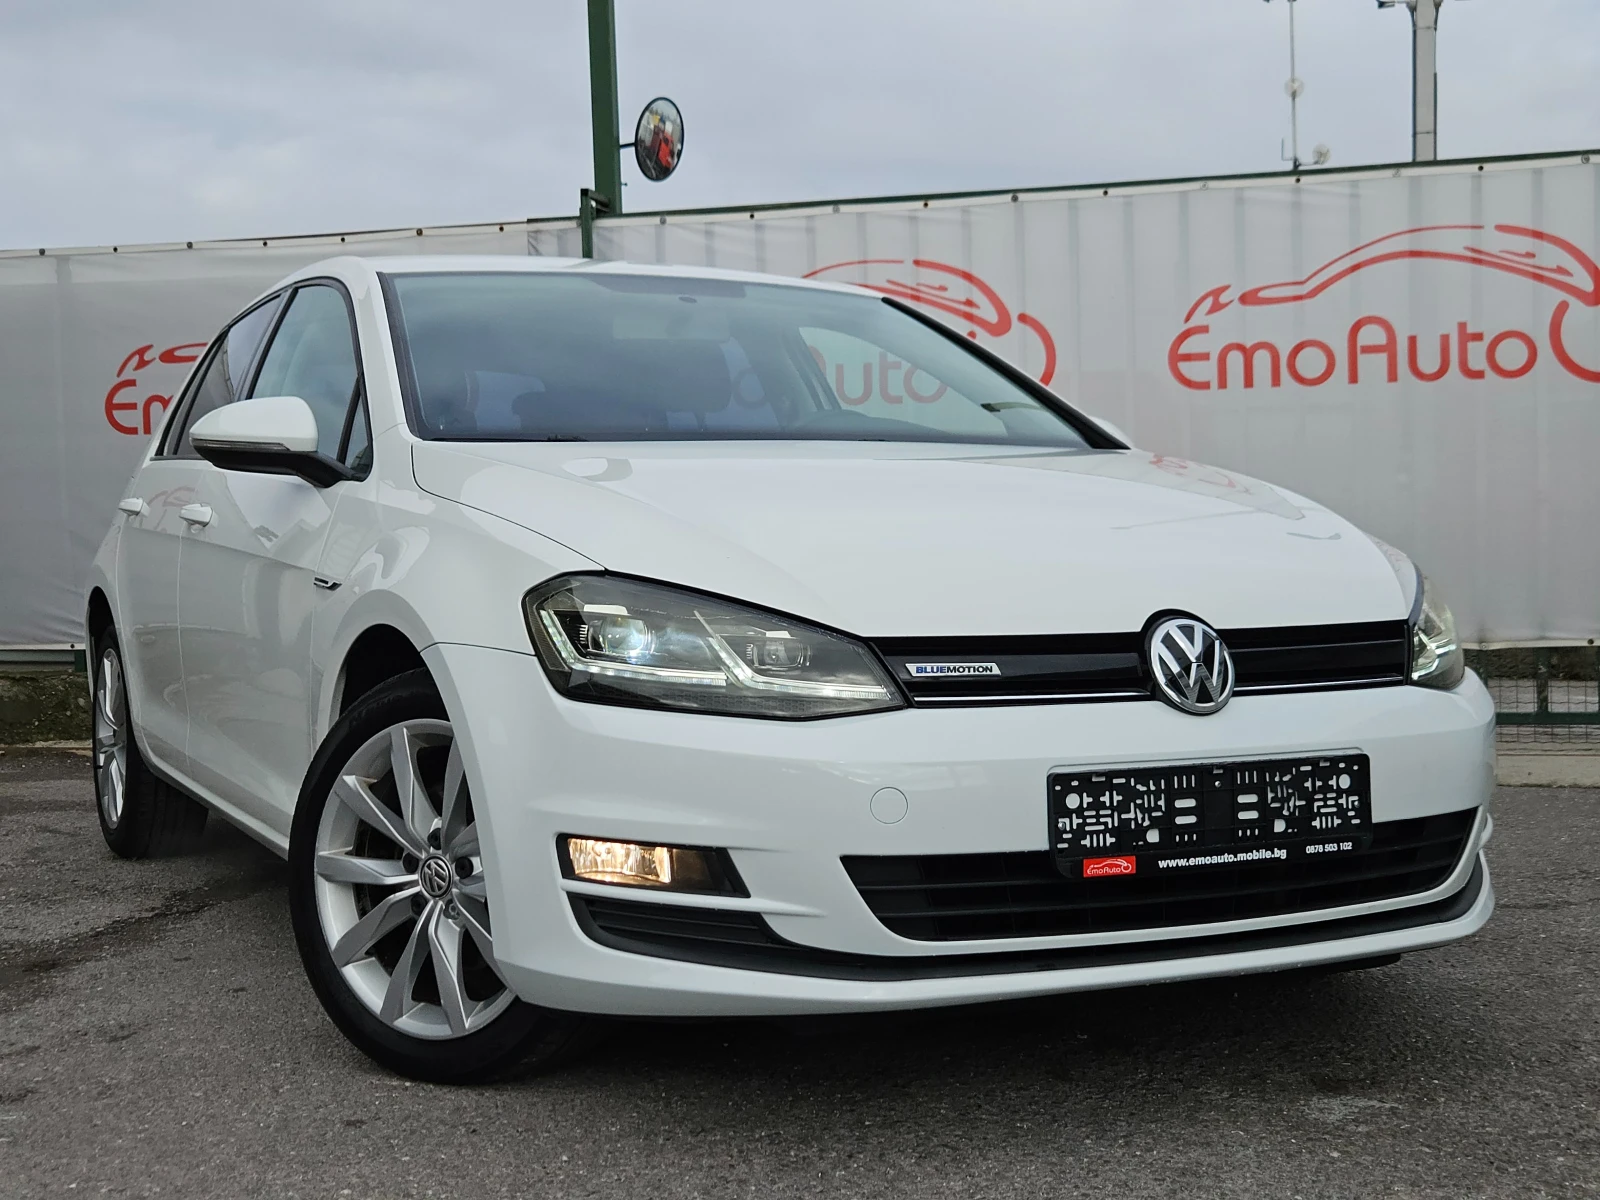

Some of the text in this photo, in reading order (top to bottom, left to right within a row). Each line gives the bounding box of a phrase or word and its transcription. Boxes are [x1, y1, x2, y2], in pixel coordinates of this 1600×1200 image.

[1167, 315, 1538, 391] EmoAuto
[915, 665, 993, 674] BLUEMOTION
[1150, 618, 1235, 714] VW
[1158, 842, 1353, 868] www.emoauto.mobile.bg 0878 503 102
[1086, 866, 1121, 875] EmoAuto
